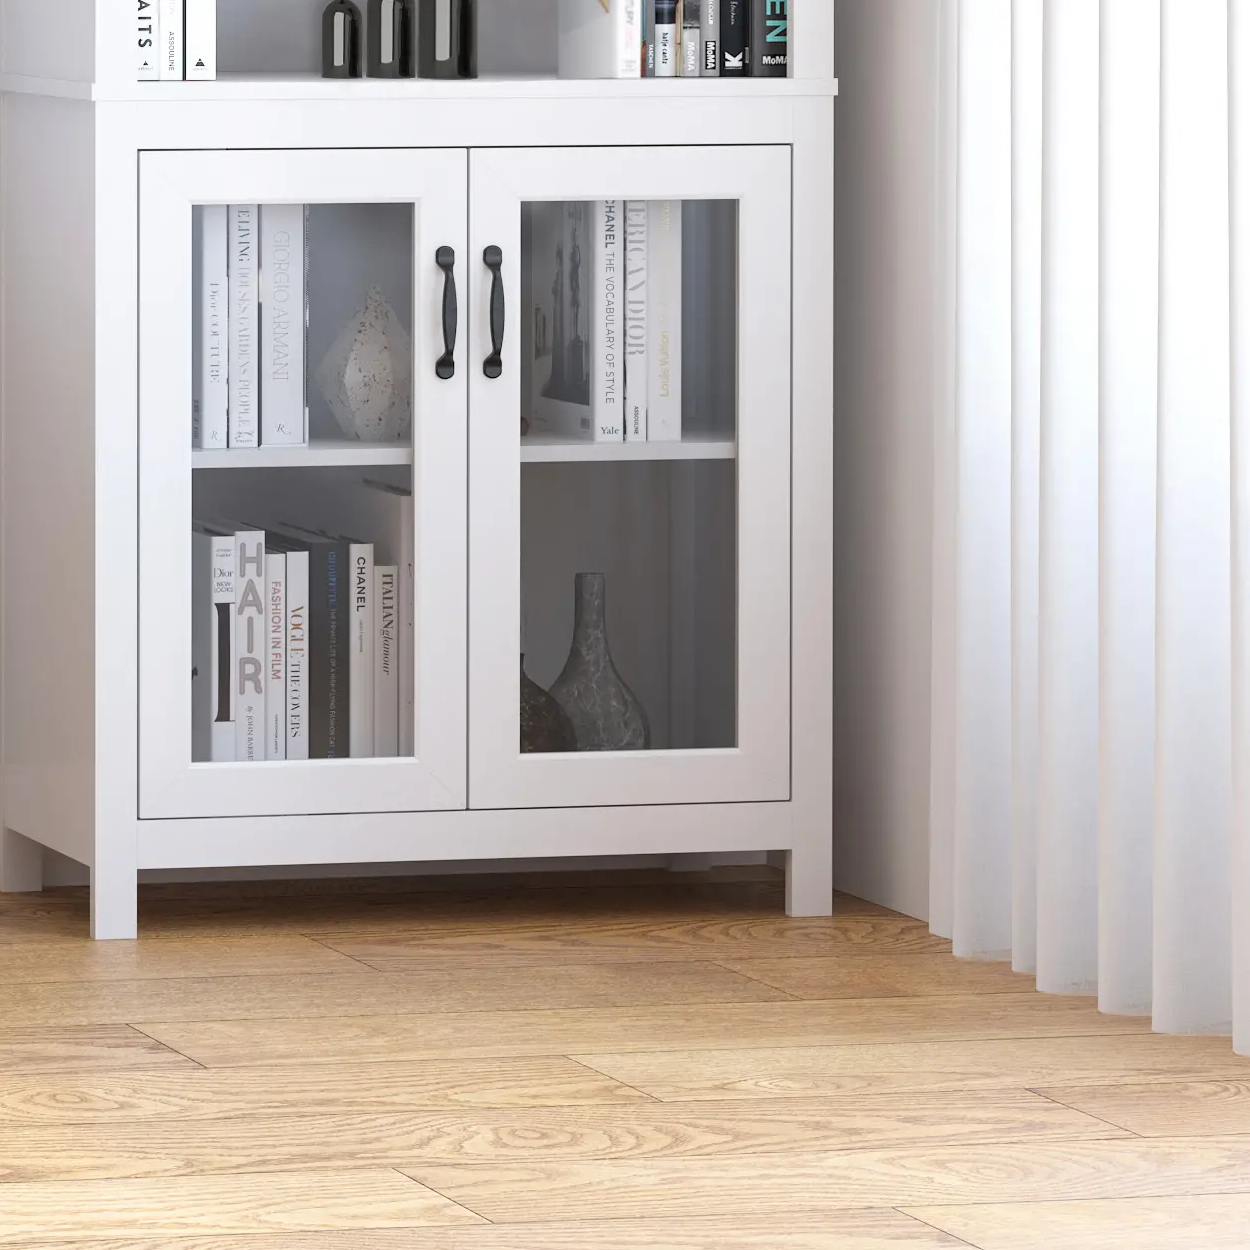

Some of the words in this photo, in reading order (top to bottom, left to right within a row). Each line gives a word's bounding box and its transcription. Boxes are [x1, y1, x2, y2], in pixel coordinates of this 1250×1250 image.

[686, 41, 695, 71] MoMA
[705, 41, 716, 70] MoMA
[272, 230, 291, 303] GIORGIO
[605, 252, 615, 273] THE
[605, 276, 615, 351] VOCABULARY
[628, 299, 645, 355] DIOR
[272, 308, 291, 383] ARMANI
[605, 353, 615, 368] OF
[605, 371, 615, 404] STYLE
[601, 426, 620, 435] Yale
[356, 557, 366, 612] CHANEL
[271, 581, 282, 633] FASHION
[271, 637, 282, 649] IN
[290, 605, 304, 659] VOGUE
[271, 652, 282, 680] FILM
[291, 661, 301, 686] THE
[246, 715, 254, 736] JOHN
[291, 688, 301, 738] COVERS
